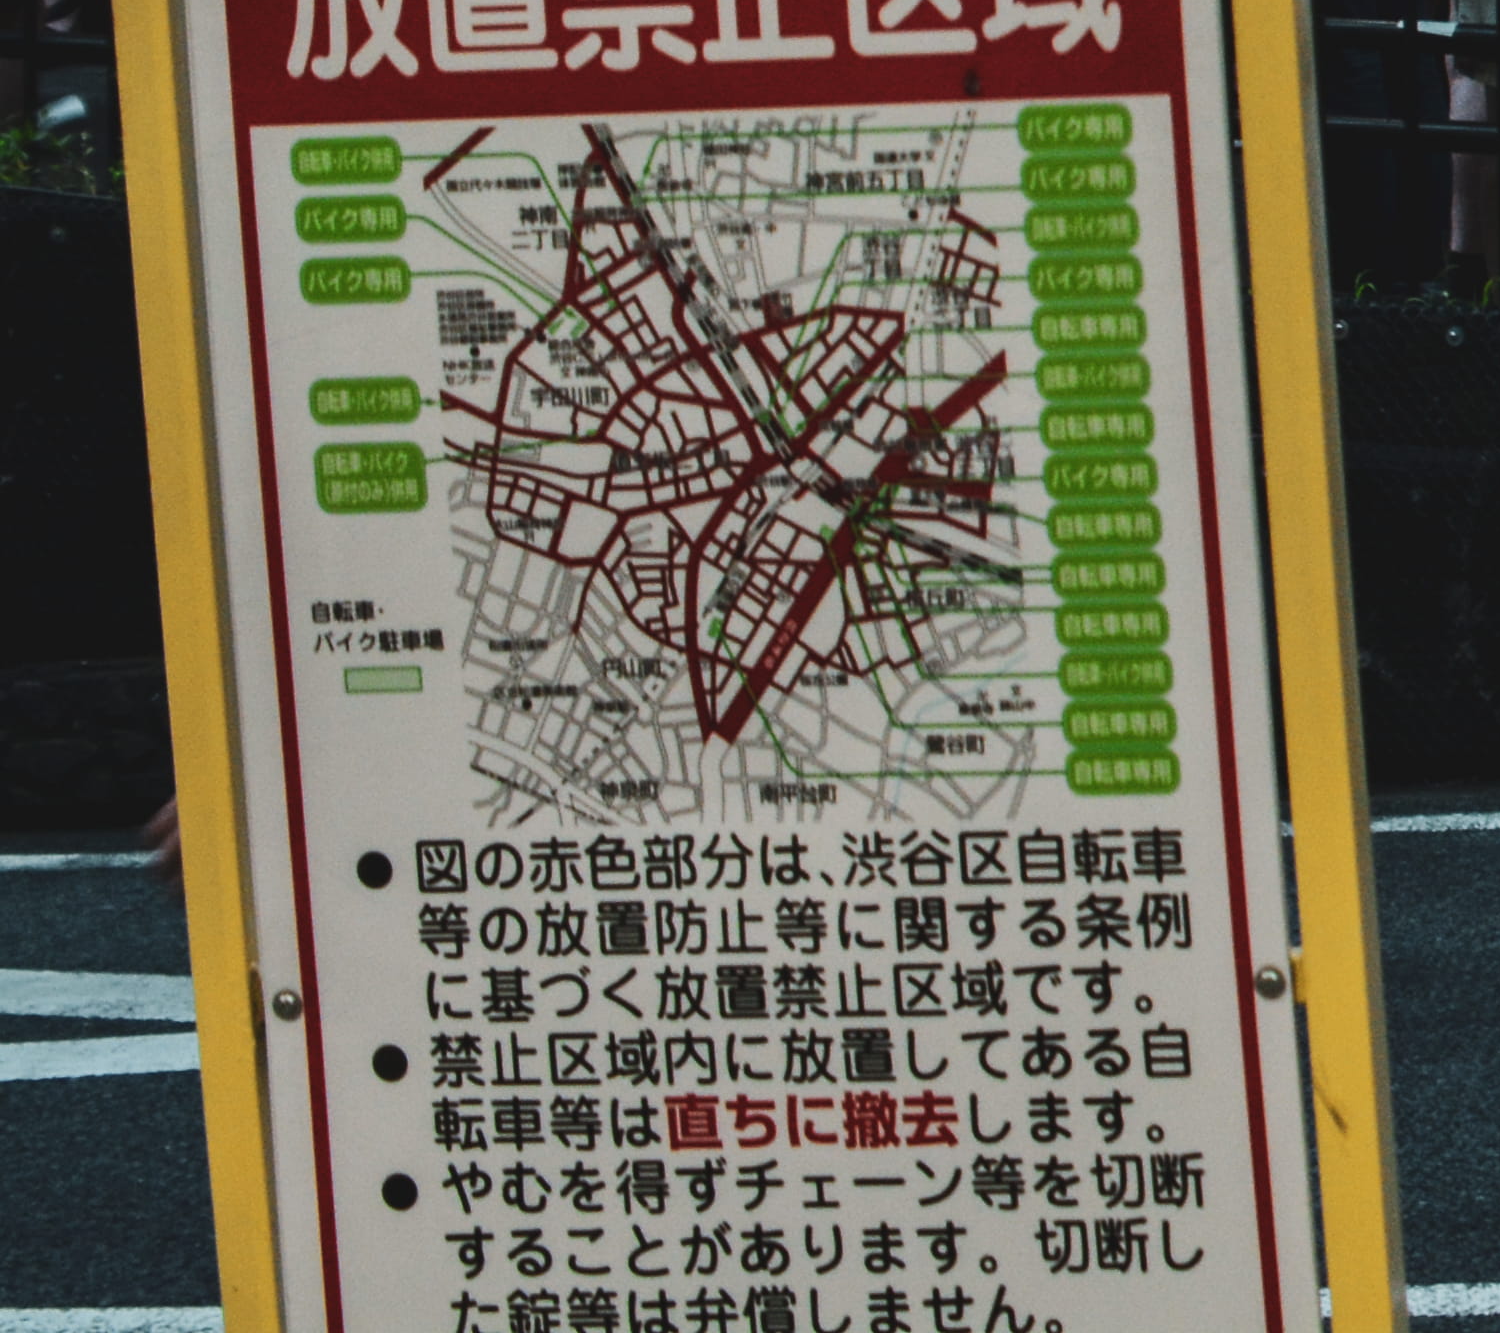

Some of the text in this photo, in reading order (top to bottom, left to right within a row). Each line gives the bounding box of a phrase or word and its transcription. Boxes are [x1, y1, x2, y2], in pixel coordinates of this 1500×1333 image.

[1026, 115, 1123, 141] バイク専用
[1029, 164, 1127, 191] バイク専用
[303, 206, 398, 232] バイク専用
[308, 268, 403, 295] バイク専用
[1036, 264, 1134, 292] バイク専用
[1052, 462, 1150, 488] バイク専用
[414, 830, 1188, 894] 図の赤色部分は、渋谷区自転車
[416, 891, 1194, 960] 等の放置防止等に関する条例
[424, 961, 1157, 1025] に基づく放置禁止区域です。
[429, 1023, 1193, 1091] 禁止区域内に放置してある自
[431, 1089, 1168, 1154] 転車等は直ちに撤去します。
[441, 1151, 1206, 1215] やむを得ずチェーン等を切断
[444, 1217, 1206, 1281] することがあります。切断し
